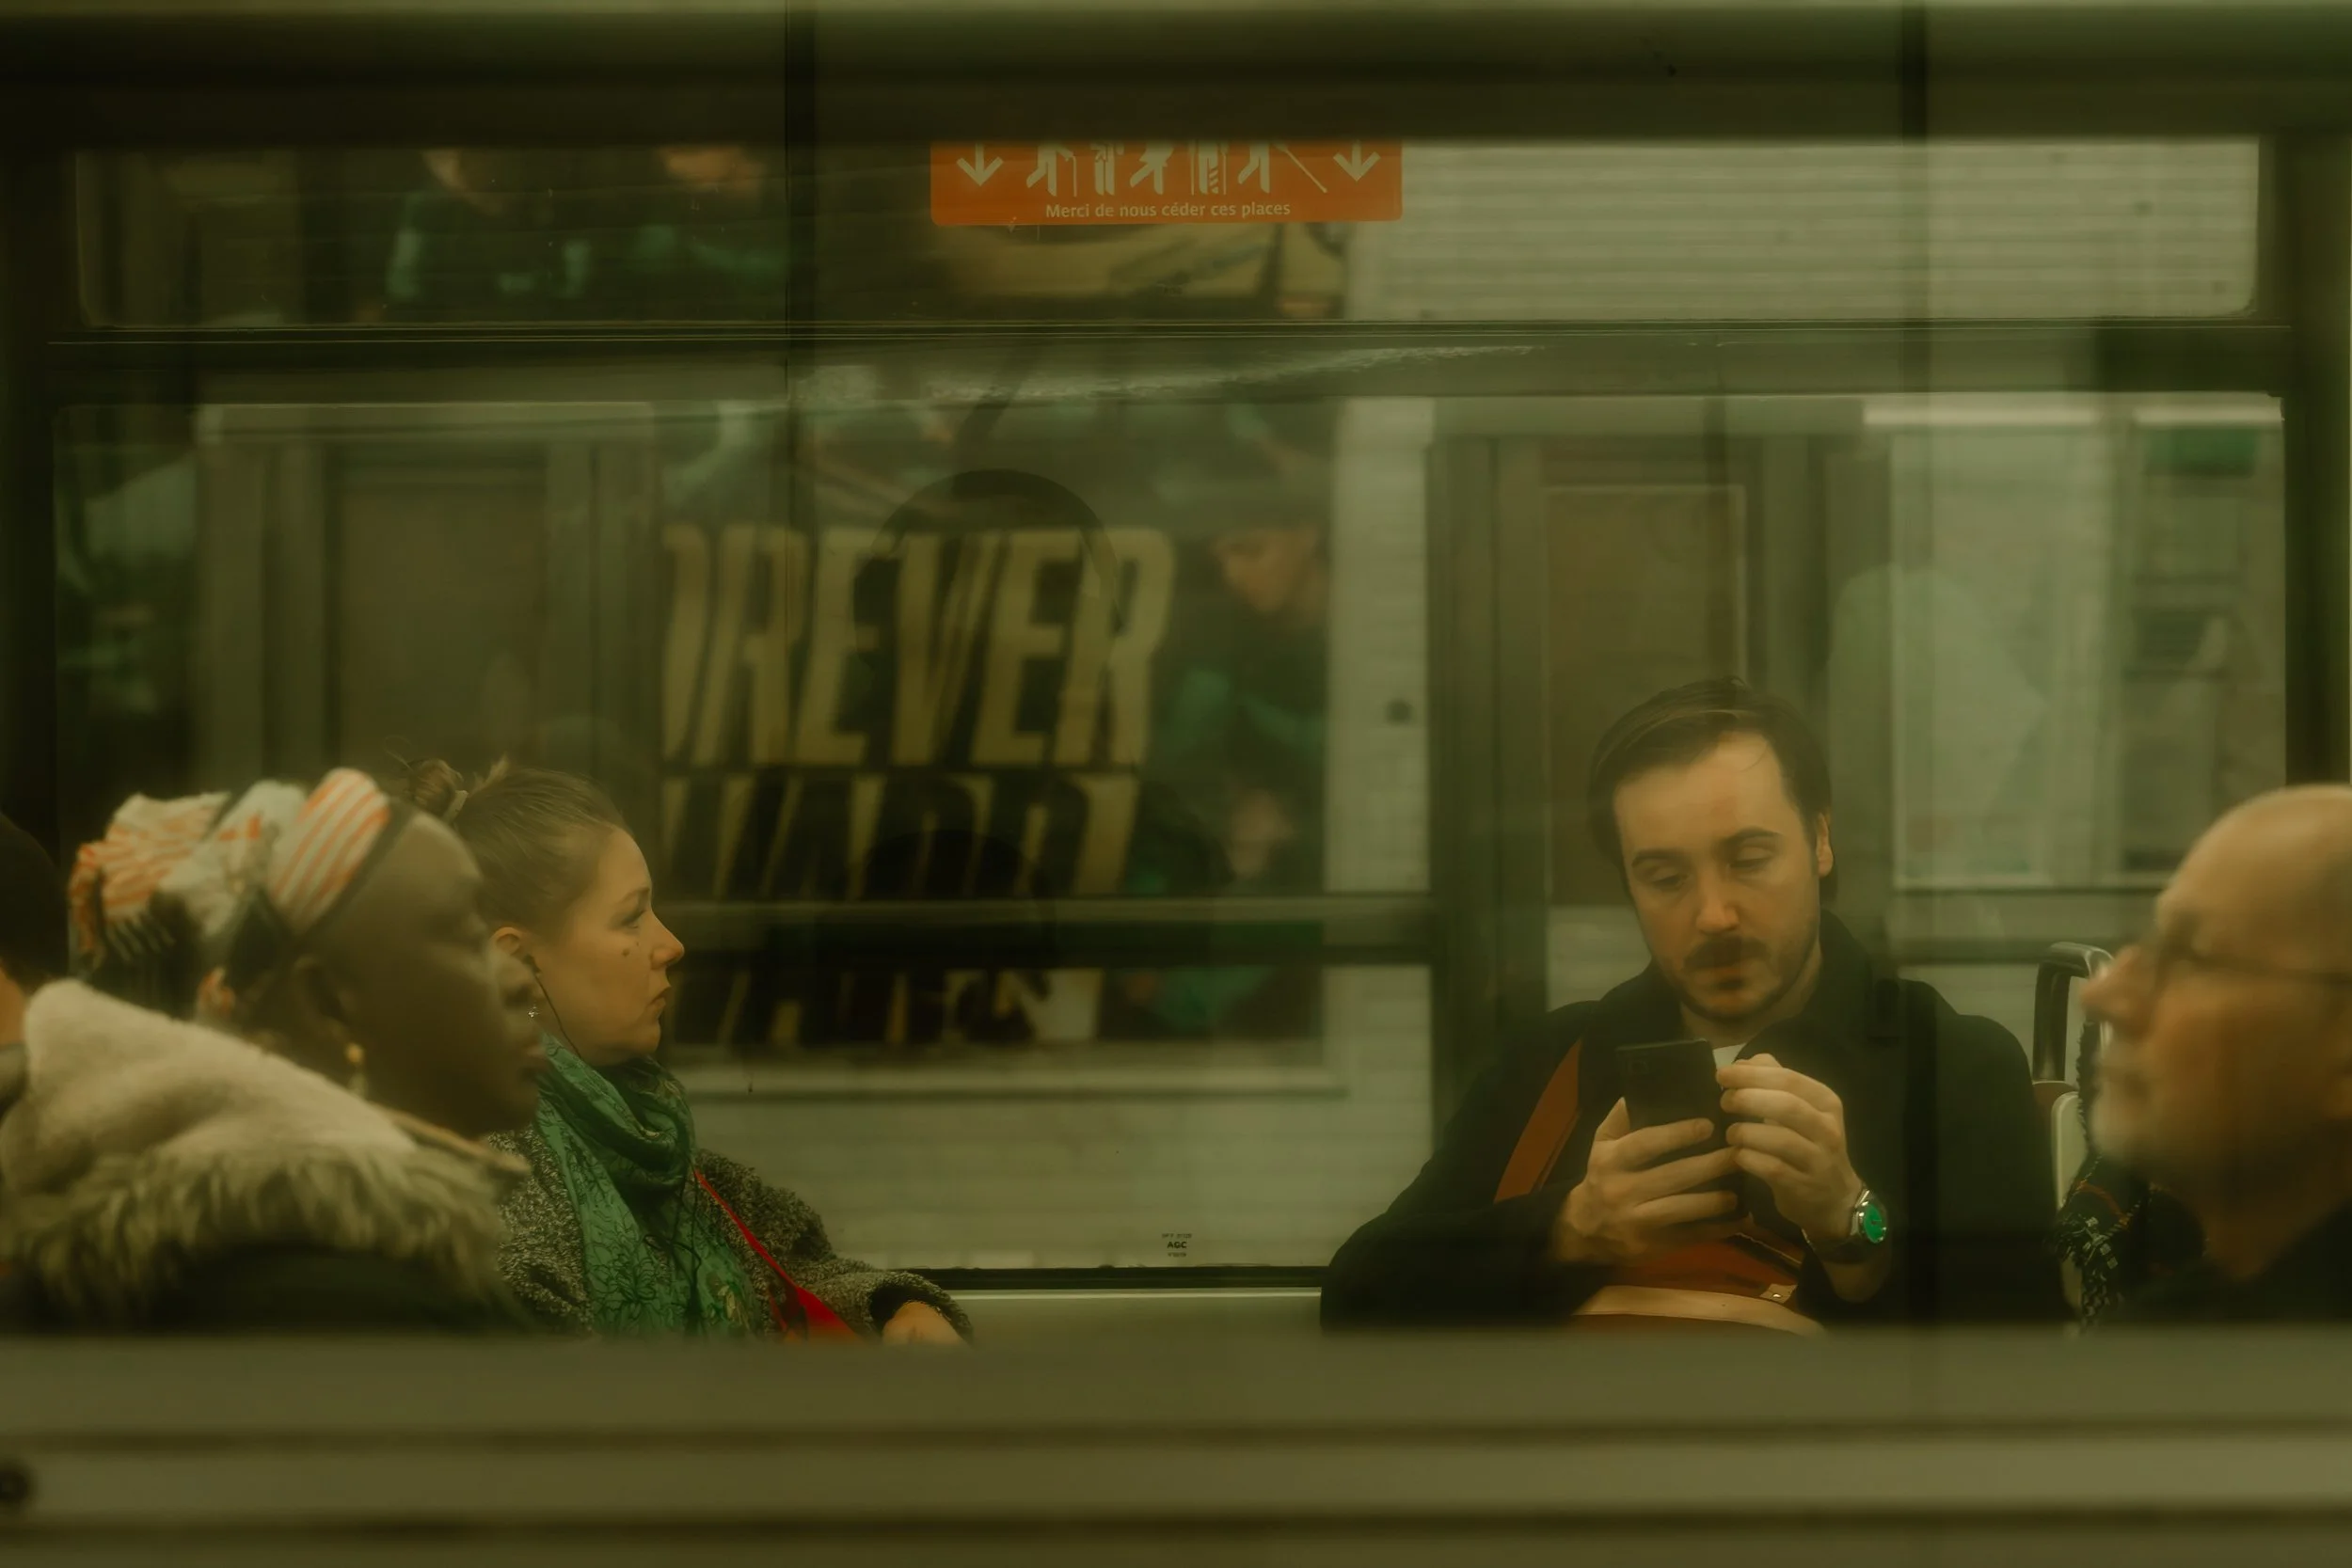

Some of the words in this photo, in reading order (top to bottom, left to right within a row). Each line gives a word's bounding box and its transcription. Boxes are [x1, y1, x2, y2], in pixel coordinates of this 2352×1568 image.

[1046, 203, 1089, 217] Merci
[1095, 203, 1115, 217] de
[1120, 206, 1157, 217] nous
[1161, 202, 1205, 216] céder
[1210, 204, 1237, 216] ces
[1242, 201, 1291, 218] places
[1167, 1241, 1187, 1249] AGC
